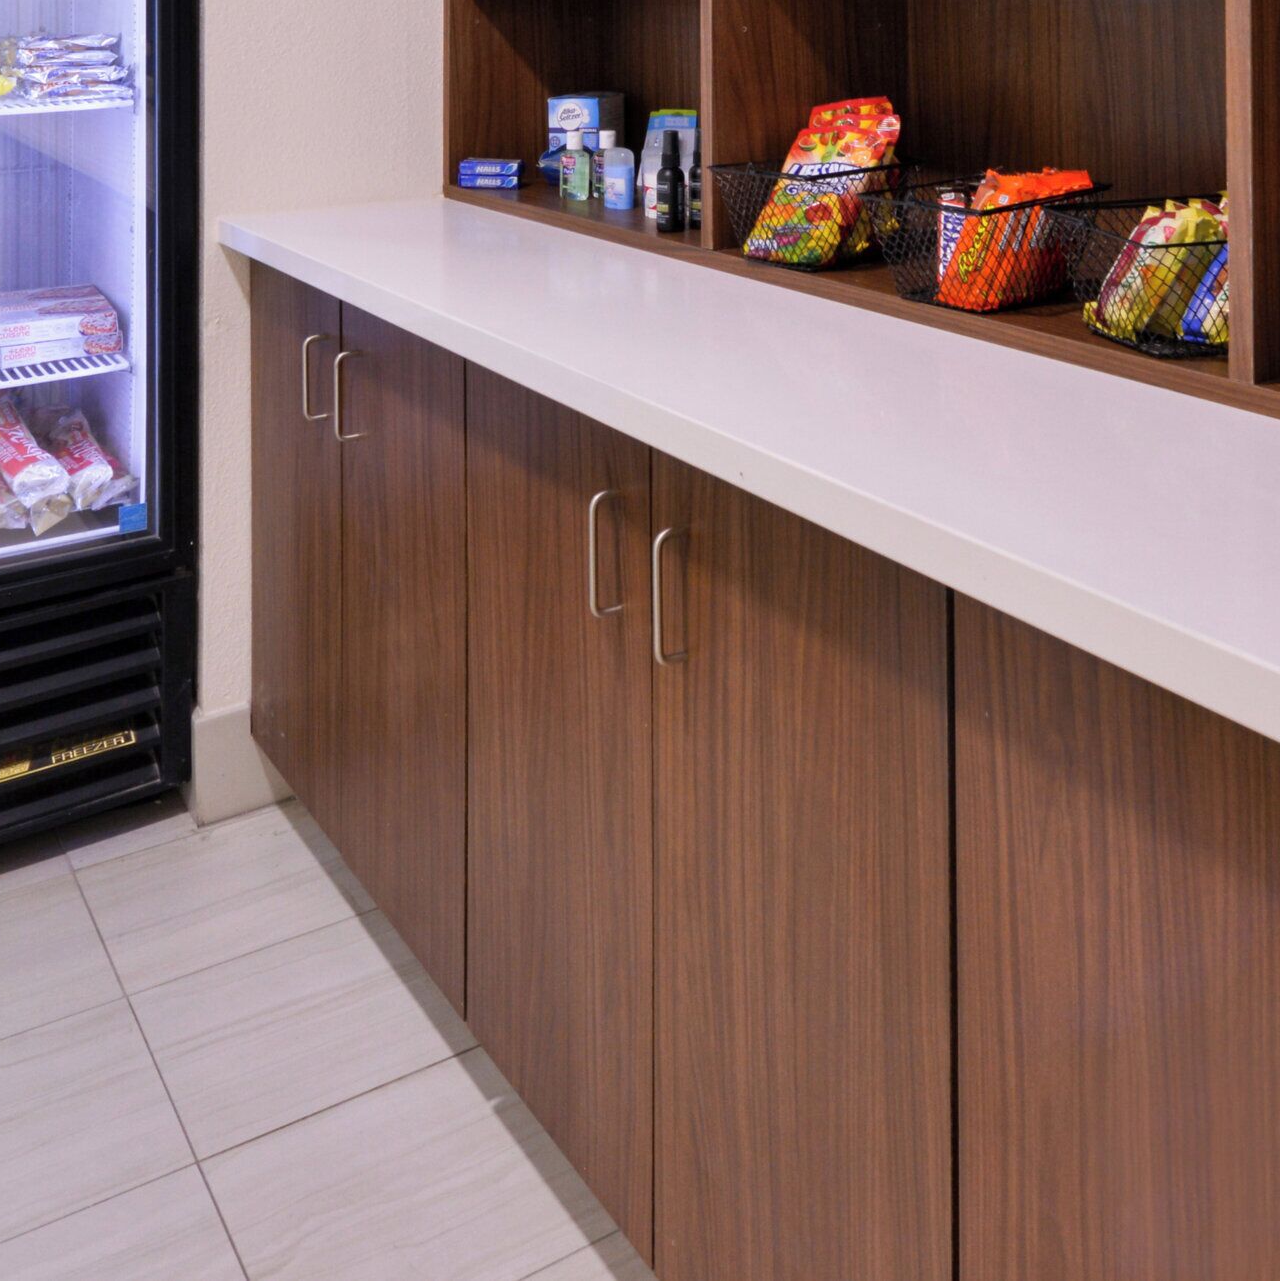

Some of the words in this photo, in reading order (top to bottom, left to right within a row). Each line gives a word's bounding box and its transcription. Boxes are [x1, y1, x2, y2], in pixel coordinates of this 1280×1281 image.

[476, 165, 501, 173] HALLS
[477, 178, 501, 186] HALLS
[52, 735, 126, 764] FREEZER
